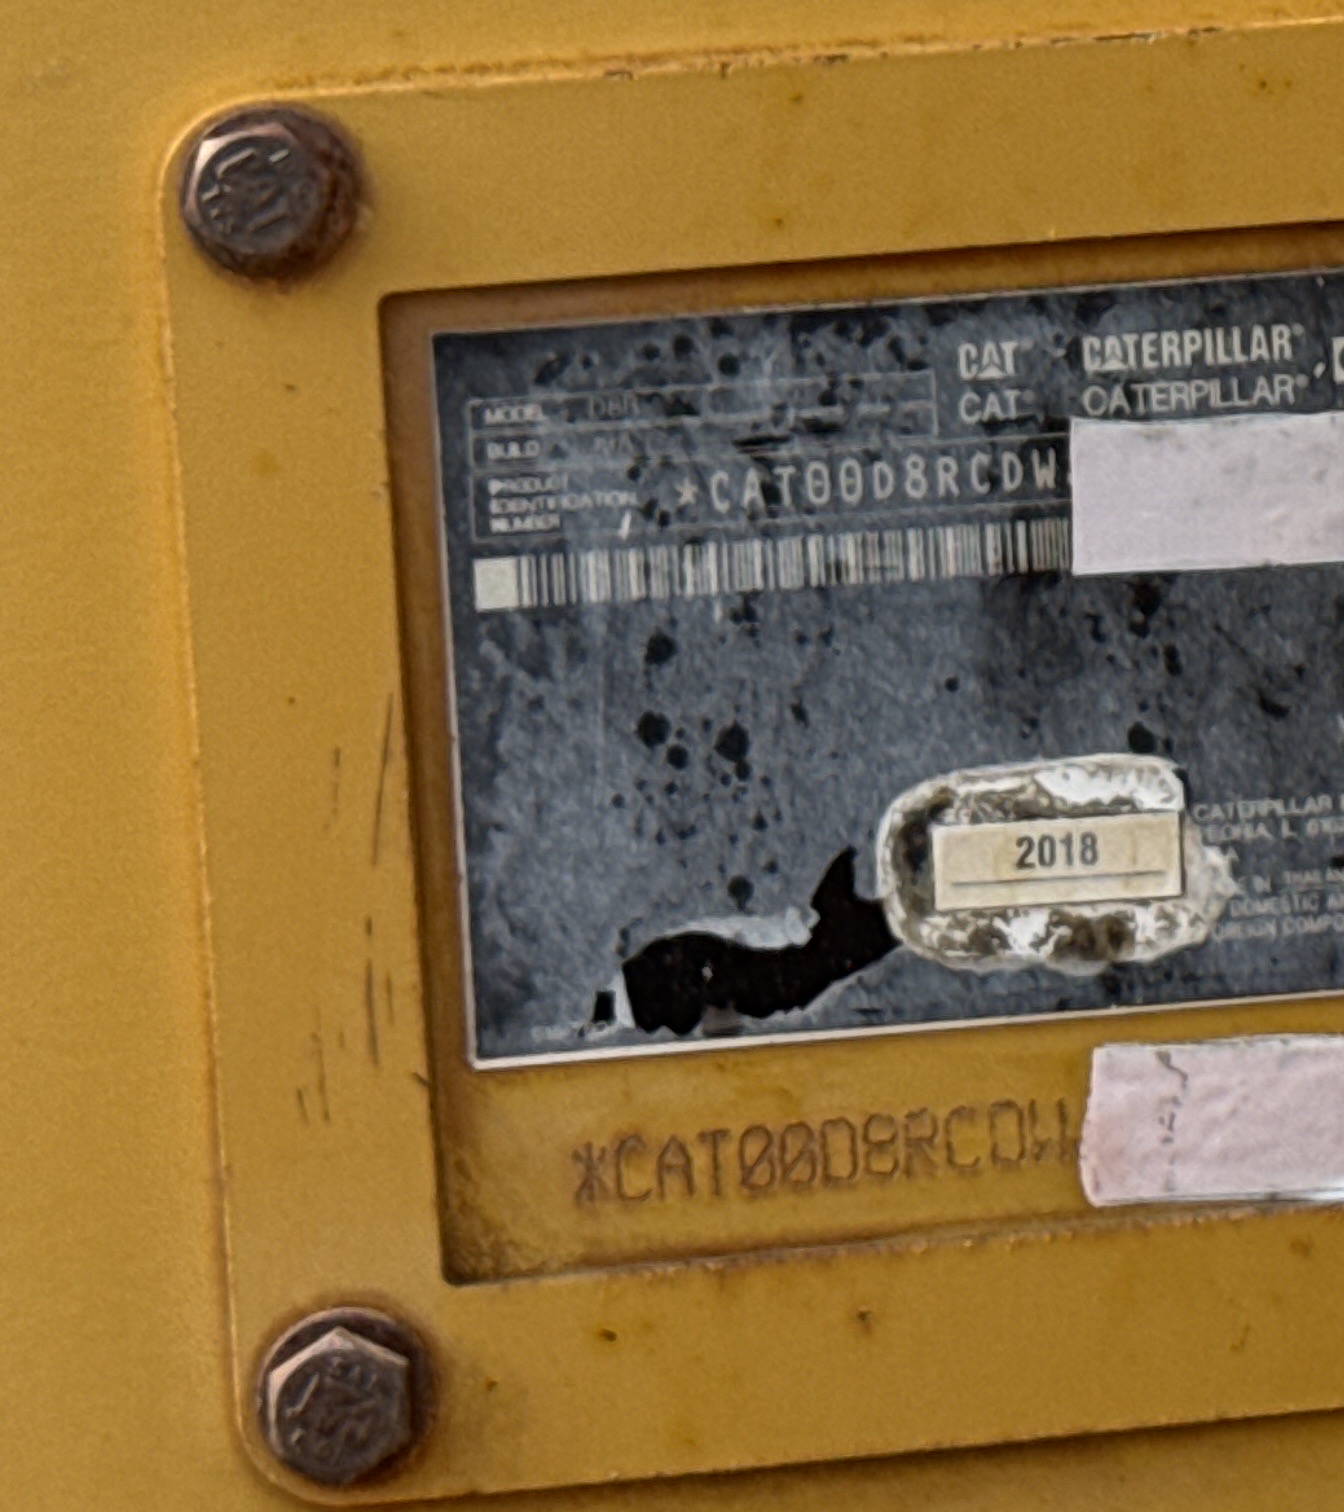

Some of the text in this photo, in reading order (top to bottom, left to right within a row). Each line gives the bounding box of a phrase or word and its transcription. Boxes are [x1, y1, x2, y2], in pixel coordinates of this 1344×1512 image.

[957, 324, 1294, 381] CAT CATERPILLAR
[957, 373, 1296, 425] CAT CATERPILLAR
[1015, 832, 1099, 870] 2018
